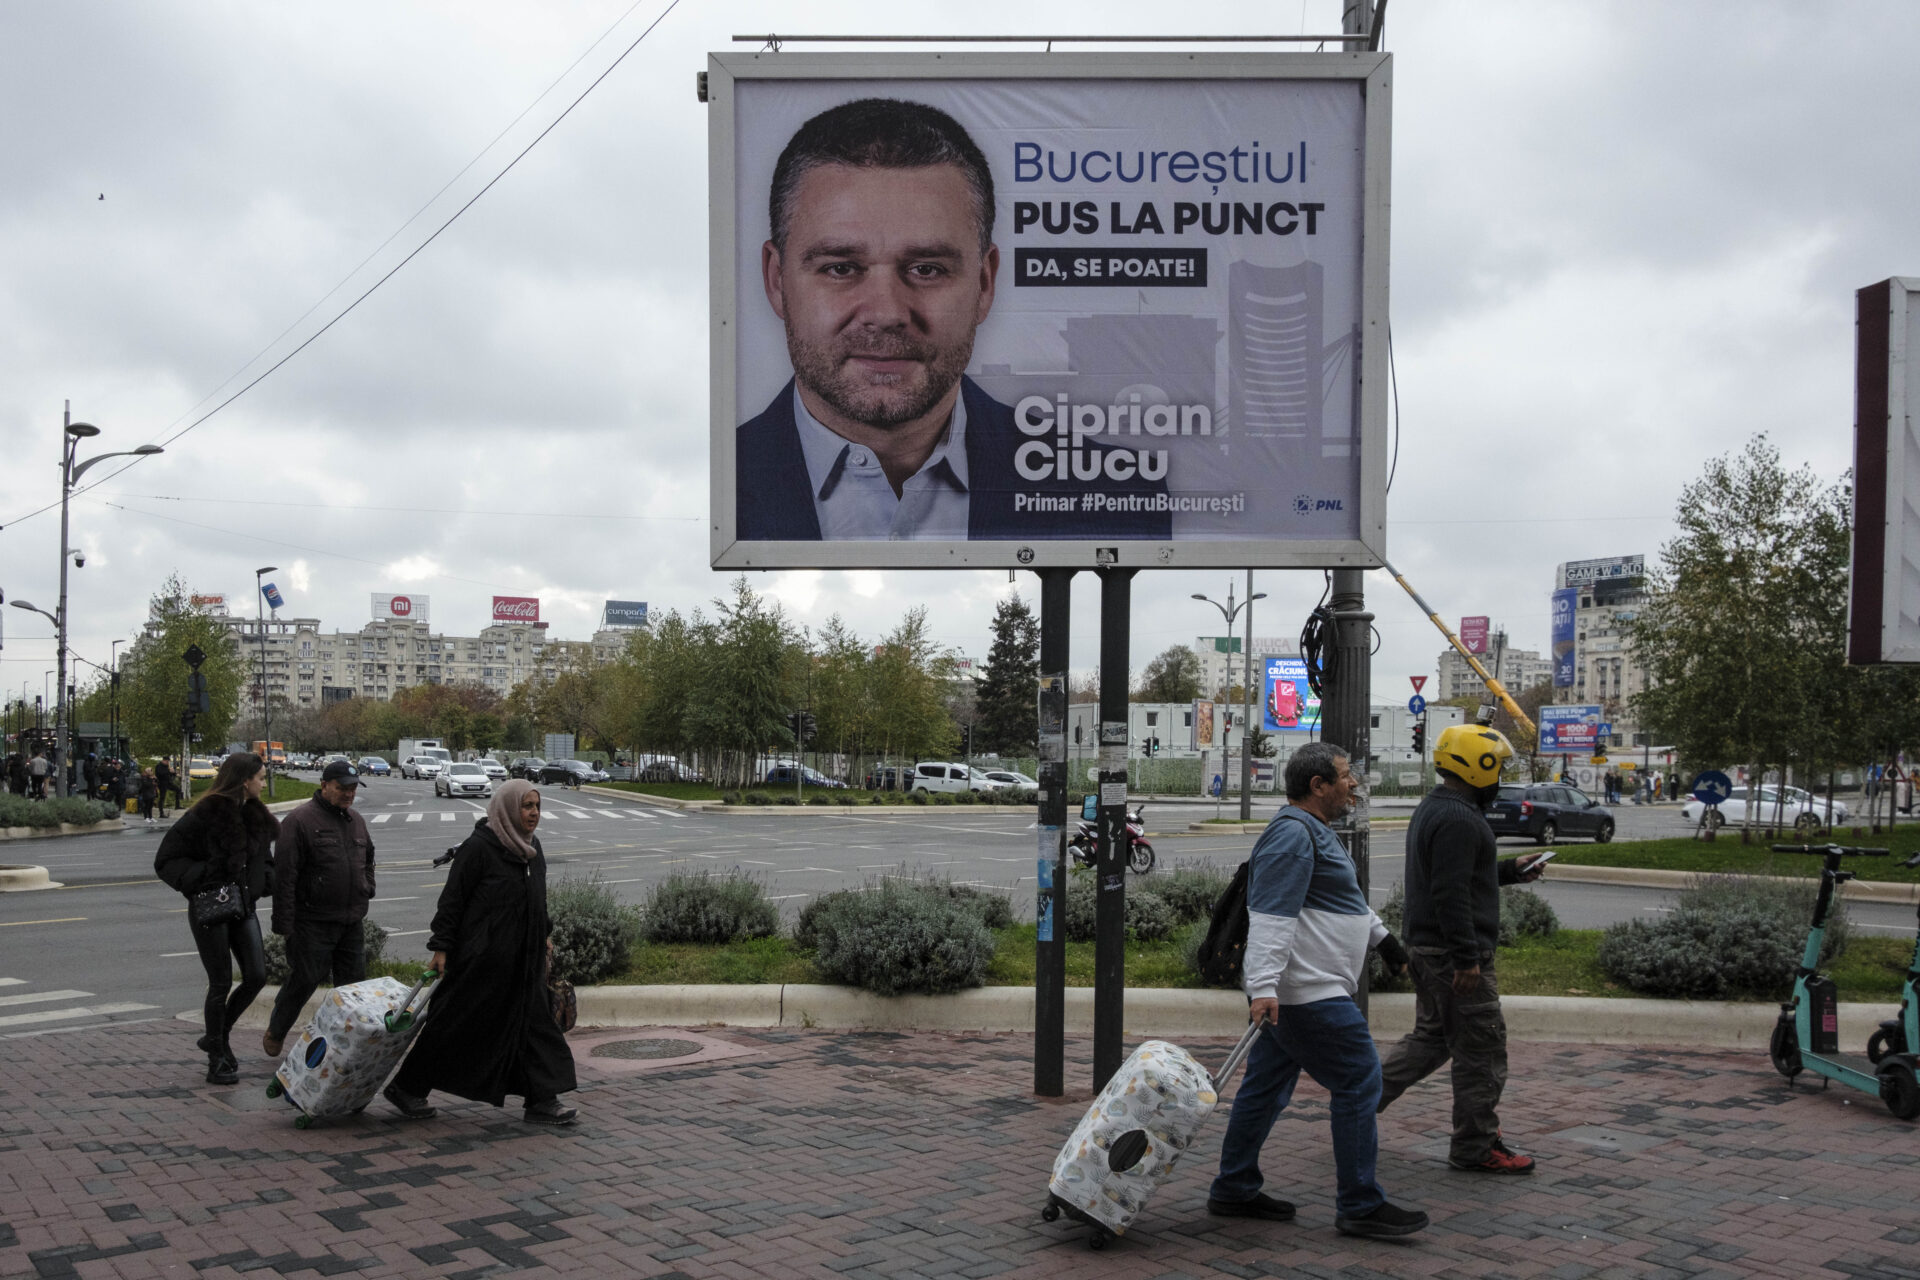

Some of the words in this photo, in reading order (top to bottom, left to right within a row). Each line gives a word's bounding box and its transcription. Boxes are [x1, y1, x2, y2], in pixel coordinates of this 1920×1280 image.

[1014, 141, 1307, 195] Bucureștiul
[1014, 200, 1099, 235] PUS
[1110, 201, 1164, 235] LA
[1174, 201, 1324, 236] PUNCT
[1026, 259, 1067, 282] DA,
[1074, 259, 1102, 278] SE
[1108, 259, 1195, 278] POATE!
[1014, 394, 1212, 446] Ciprian
[1014, 440, 1169, 482] Ciucu
[1014, 493, 1078, 512] Primar
[1081, 492, 1246, 516] #PentruBucurești
[1315, 500, 1344, 512] PNL
[1566, 567, 1601, 580] GAME
[494, 601, 537, 618] Coca-Cola
[1242, 637, 1292, 652] SILICA
